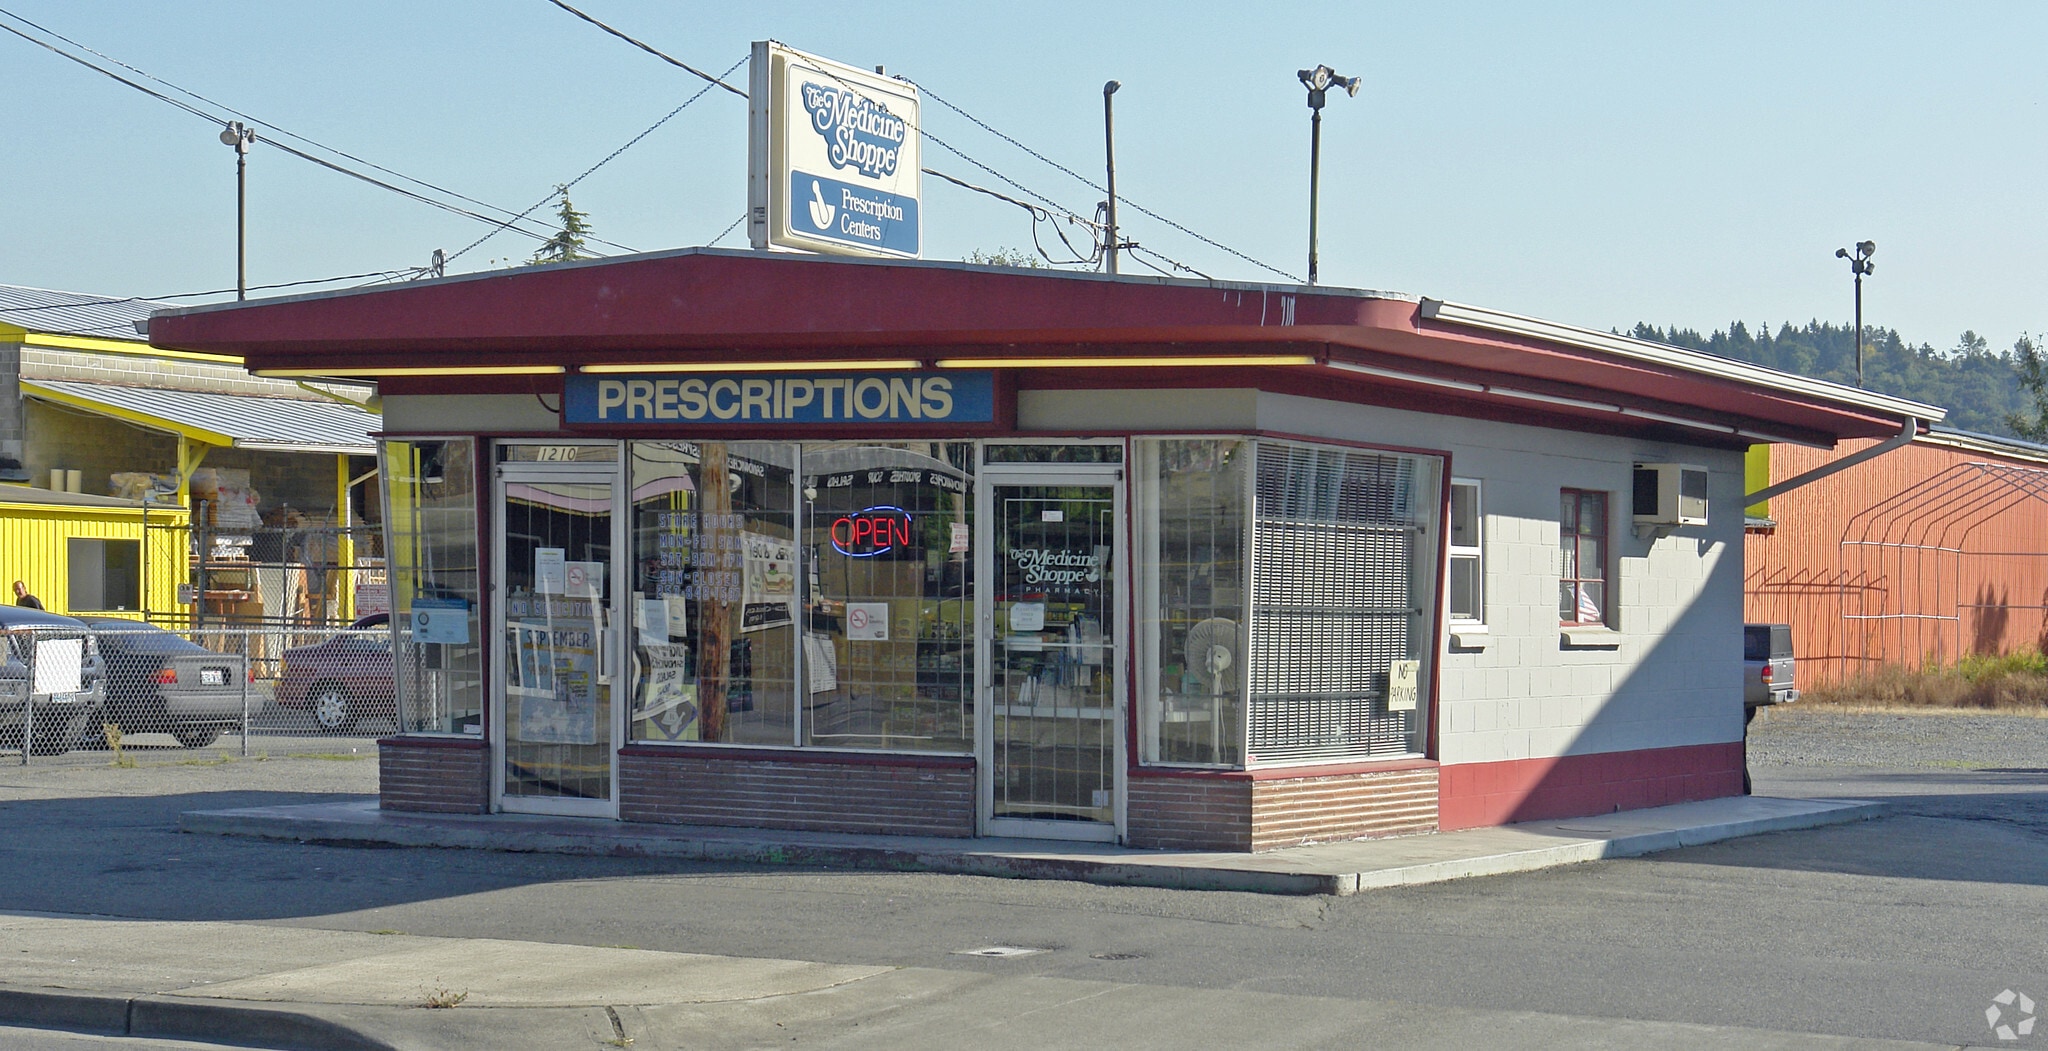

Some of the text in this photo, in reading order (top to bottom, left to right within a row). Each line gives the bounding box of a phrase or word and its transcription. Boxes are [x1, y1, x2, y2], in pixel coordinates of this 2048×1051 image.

[806, 87, 904, 142] The Medicine
[832, 126, 896, 173] Shoppe
[841, 188, 903, 222] Prescription
[841, 213, 881, 241] Centers
[598, 377, 954, 420] PRESCRIPTIONS
[541, 447, 576, 461] 1210
[831, 517, 909, 547] OPEN
[1018, 549, 1099, 569] Medicine
[1026, 564, 1085, 585] Shoppe
[1025, 586, 1099, 597] PHARMACY
[1397, 663, 1409, 680] NO
[1390, 685, 1417, 703] PARKING
